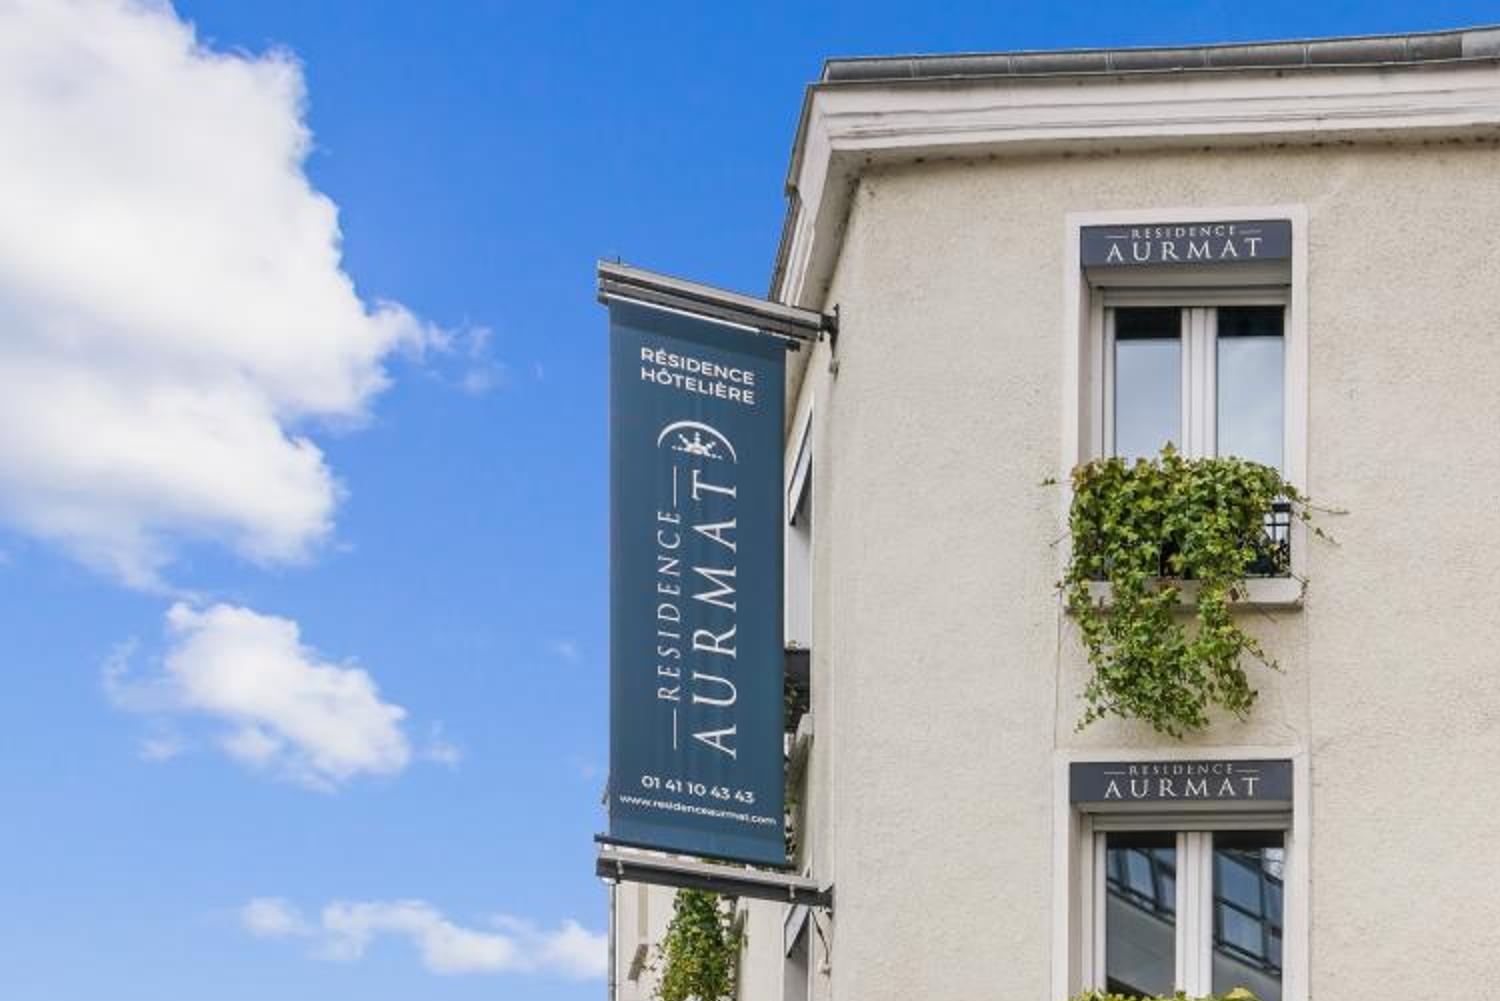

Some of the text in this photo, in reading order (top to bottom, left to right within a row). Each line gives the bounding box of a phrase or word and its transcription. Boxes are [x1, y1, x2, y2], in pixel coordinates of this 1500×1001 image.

[1131, 225, 1235, 240] RESIDENCE
[1106, 237, 1263, 263] AURMAT
[640, 347, 756, 387] RÉSIDENCE
[640, 366, 756, 405] HÔTELIÈRE
[657, 511, 681, 701] RESIDENCE
[692, 469, 737, 761] AURMAT
[1128, 763, 1234, 776] RESIDENCE
[641, 775, 755, 805] 01 41 10 43 43
[1103, 776, 1261, 799] AURMAT
